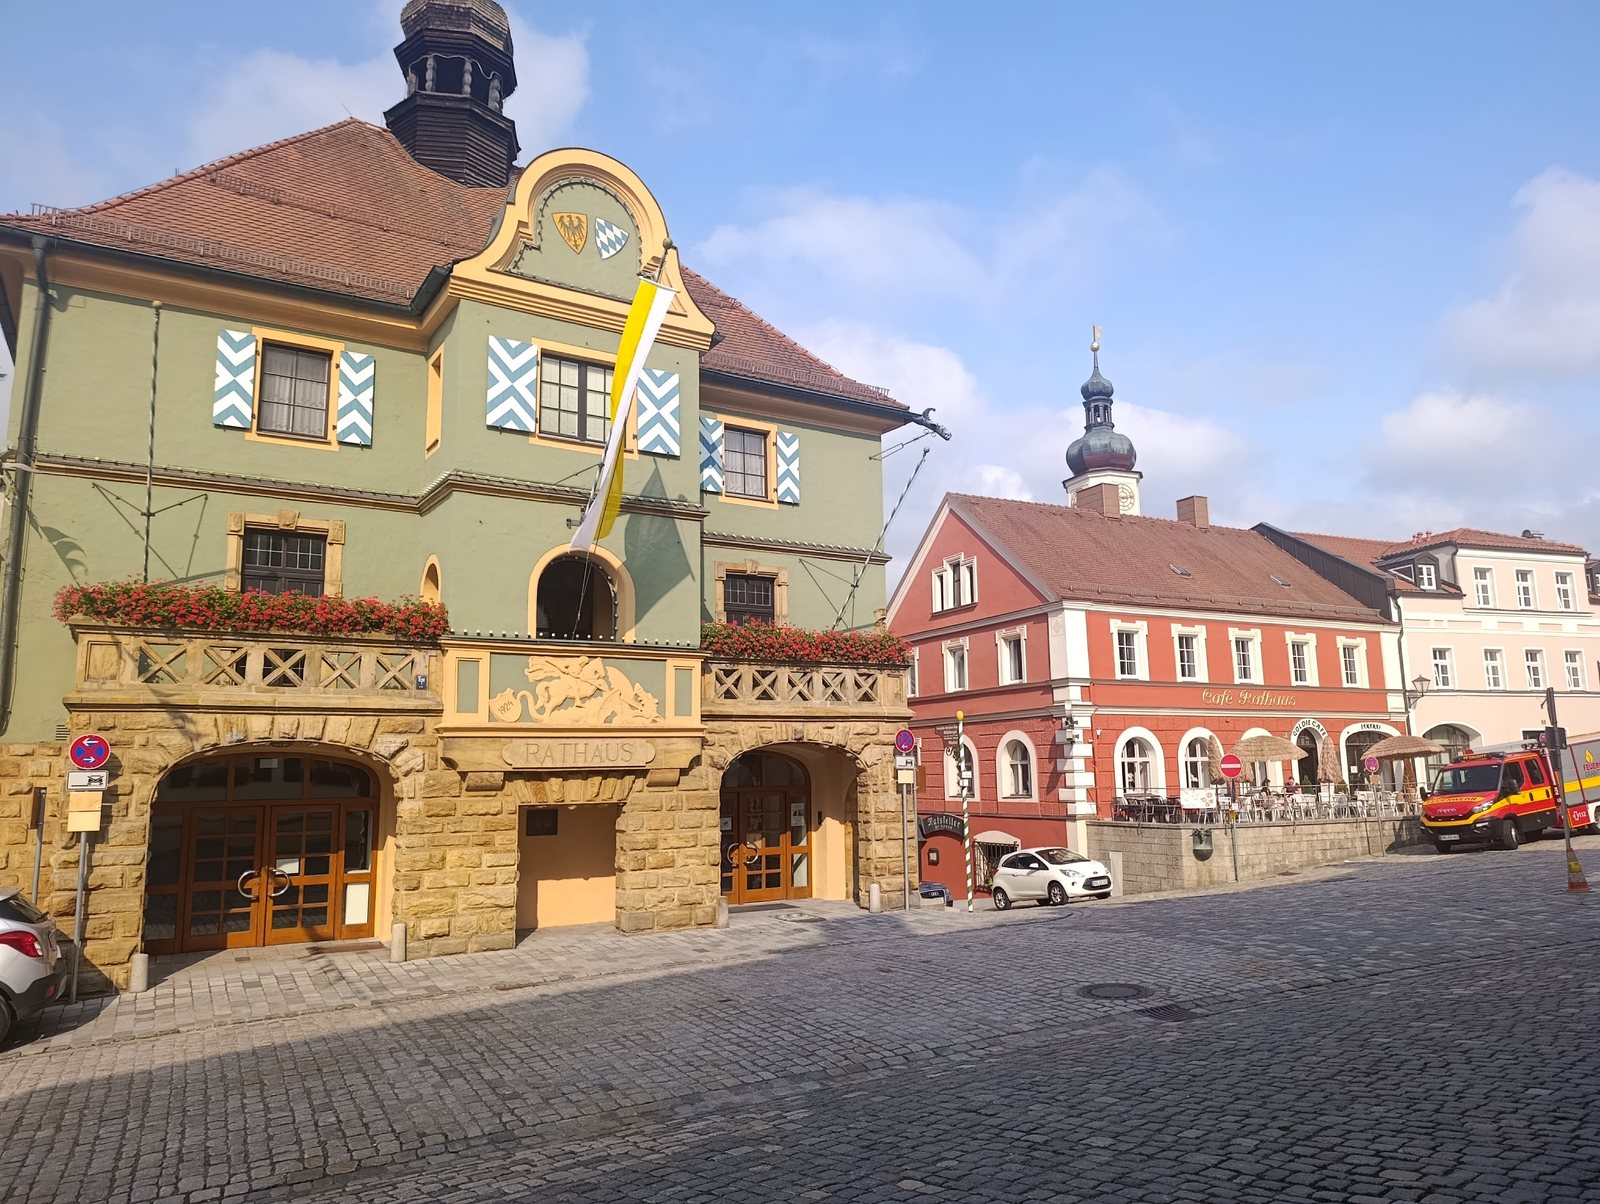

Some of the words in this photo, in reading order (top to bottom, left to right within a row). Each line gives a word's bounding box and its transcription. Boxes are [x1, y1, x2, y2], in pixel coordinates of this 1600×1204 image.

[1238, 689, 1297, 707] Rathaus
[497, 700, 514, 715] 1924
[525, 742, 635, 764] RATHAUS
